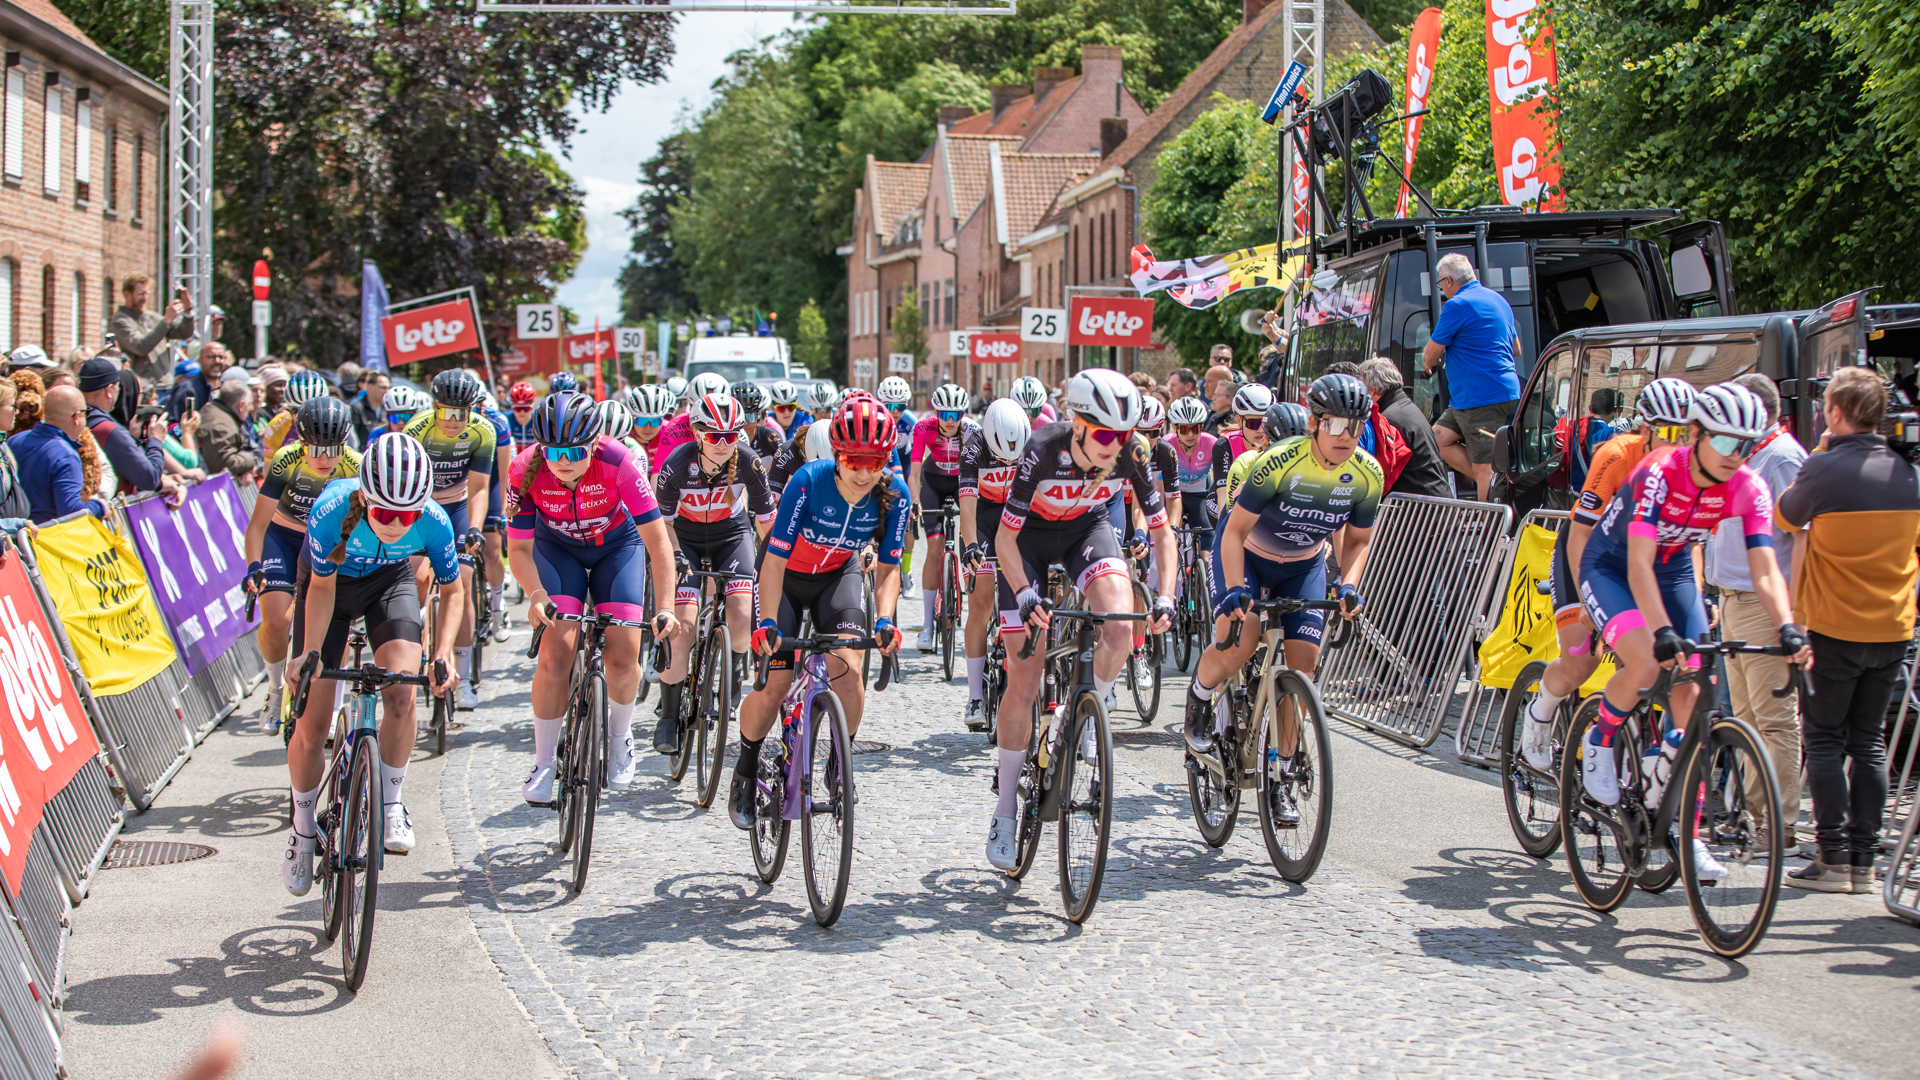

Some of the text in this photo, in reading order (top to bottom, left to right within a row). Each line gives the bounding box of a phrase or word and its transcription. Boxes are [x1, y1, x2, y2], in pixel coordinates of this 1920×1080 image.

[528, 311, 553, 332] 25
[1030, 314, 1056, 337] 25
[622, 333, 640, 348] 50
[895, 357, 908, 369] 75
[431, 458, 470, 469] ermarc
[1253, 444, 1301, 486] Gothaer
[983, 466, 1016, 484] AVI
[635, 478, 650, 498] OUT
[1331, 487, 1356, 496] ROSE
[1328, 498, 1352, 506] uvex
[1639, 476, 1660, 517] LEAD
[317, 495, 345, 519] CEUSTER
[1279, 501, 1351, 523] vermarc
[1003, 511, 1023, 526] AVIA
[770, 539, 789, 549] ABUS
[816, 534, 868, 549] balois
[1085, 562, 1111, 581] AVIA
[727, 580, 751, 590] AVIA
[1297, 625, 1322, 639] ROSE
